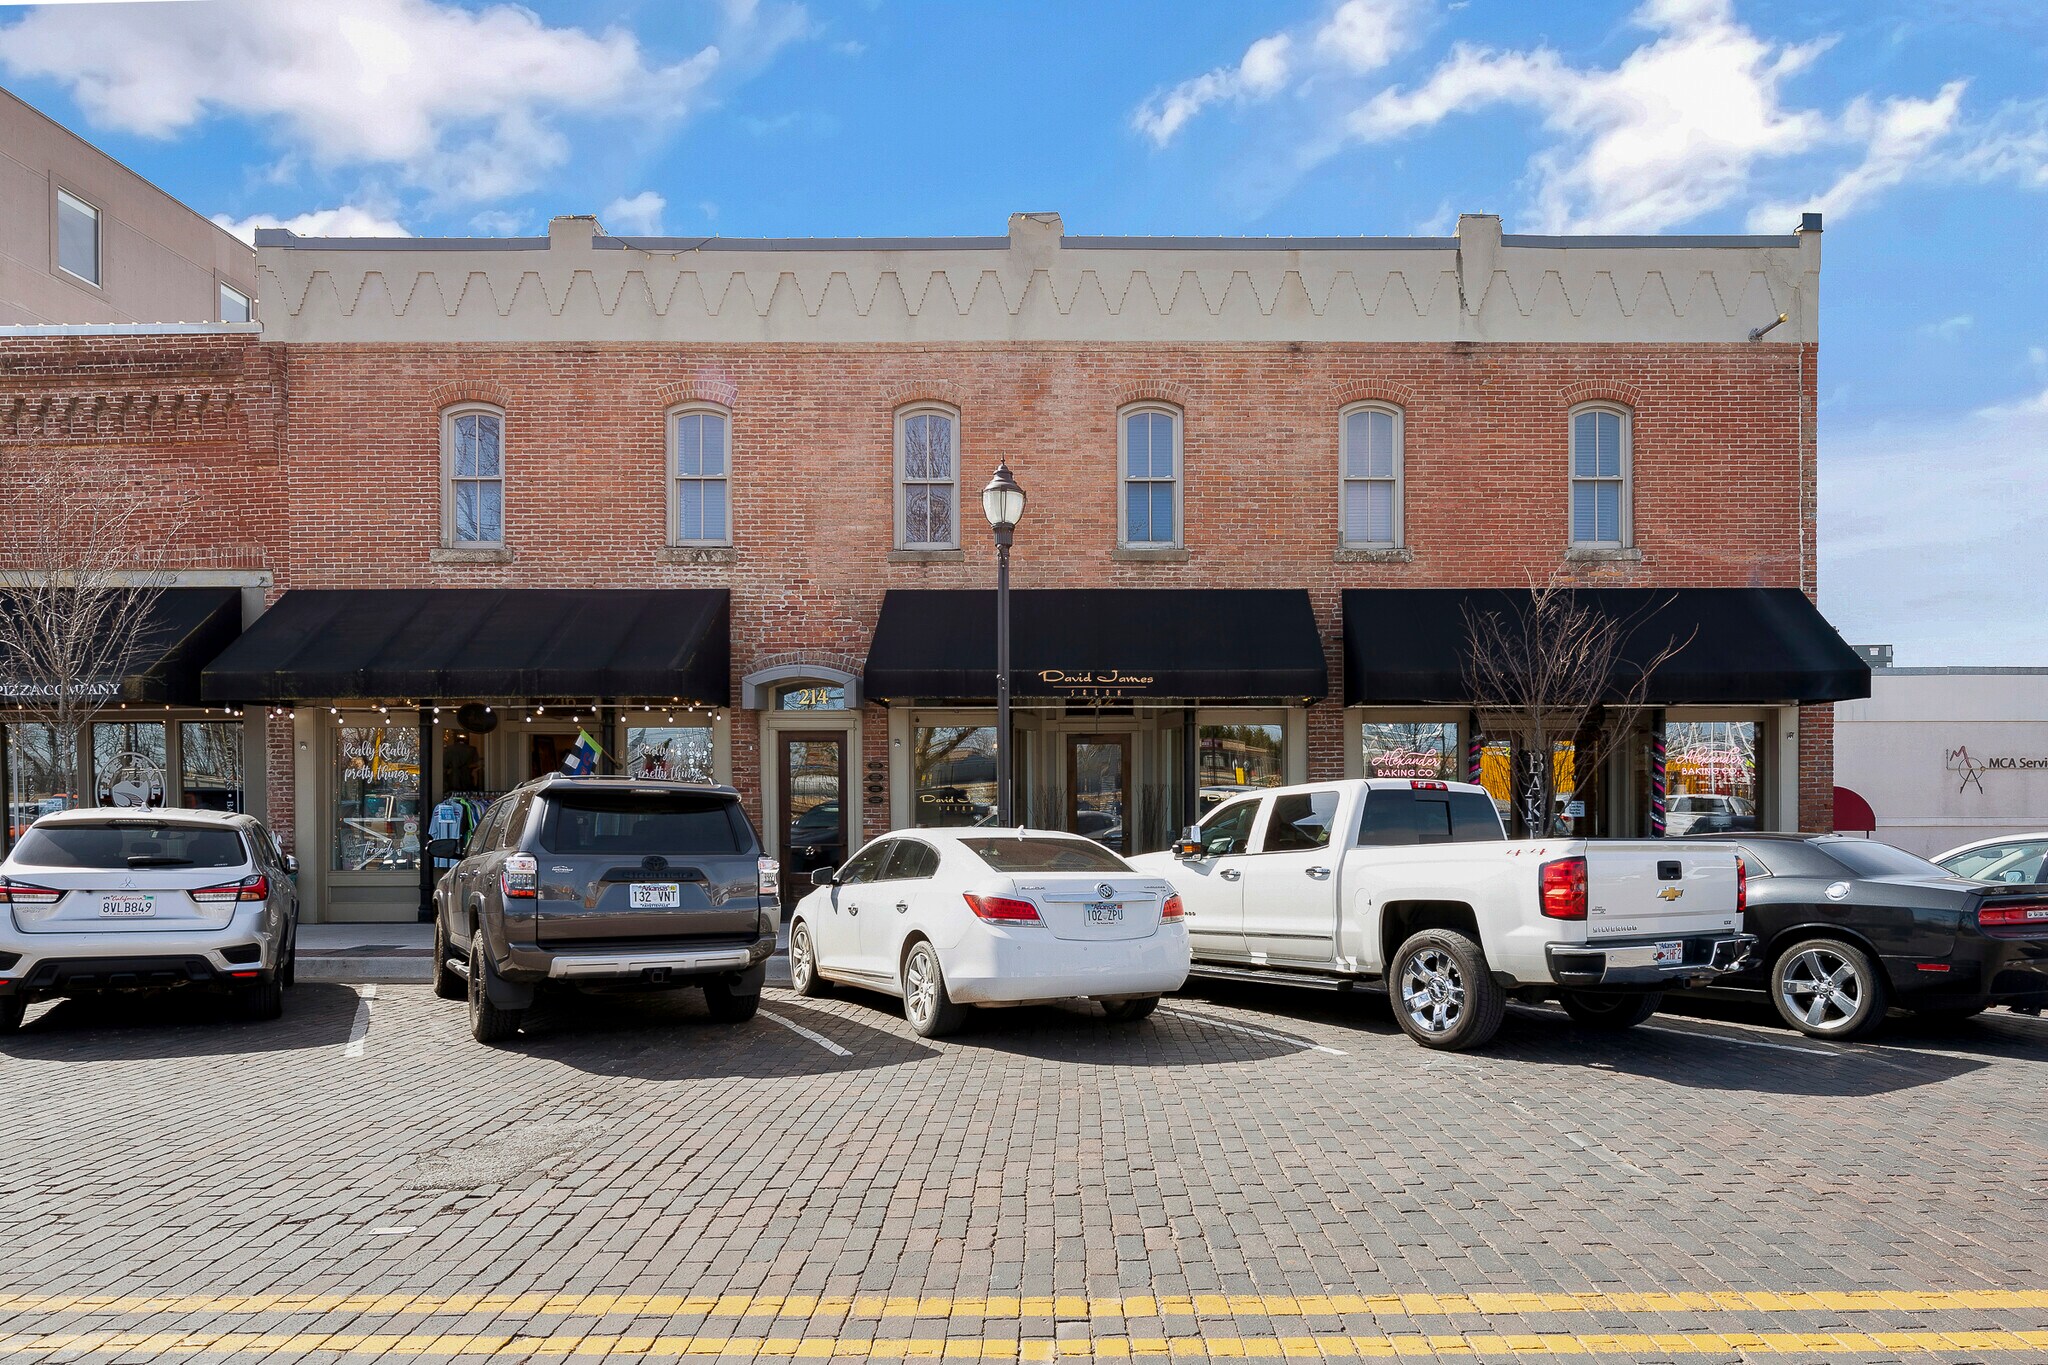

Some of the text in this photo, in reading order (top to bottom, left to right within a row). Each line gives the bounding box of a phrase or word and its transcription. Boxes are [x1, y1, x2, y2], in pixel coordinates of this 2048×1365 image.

[1038, 669, 1154, 683] David James
[798, 688, 829, 705] 214
[343, 740, 411, 761] Really Really
[1675, 746, 1745, 767] Alexander
[1371, 747, 1441, 769] Alexander
[1988, 757, 2048, 769] MCA Servi
[344, 764, 410, 784] pretty things
[1377, 769, 1416, 777] BAKING
[1681, 767, 1719, 775] BAKING
[919, 794, 954, 803] David
[633, 891, 677, 902] 132 VNT
[103, 902, 152, 913] 8VLB849
[1087, 909, 1124, 921] 102 ZPU
